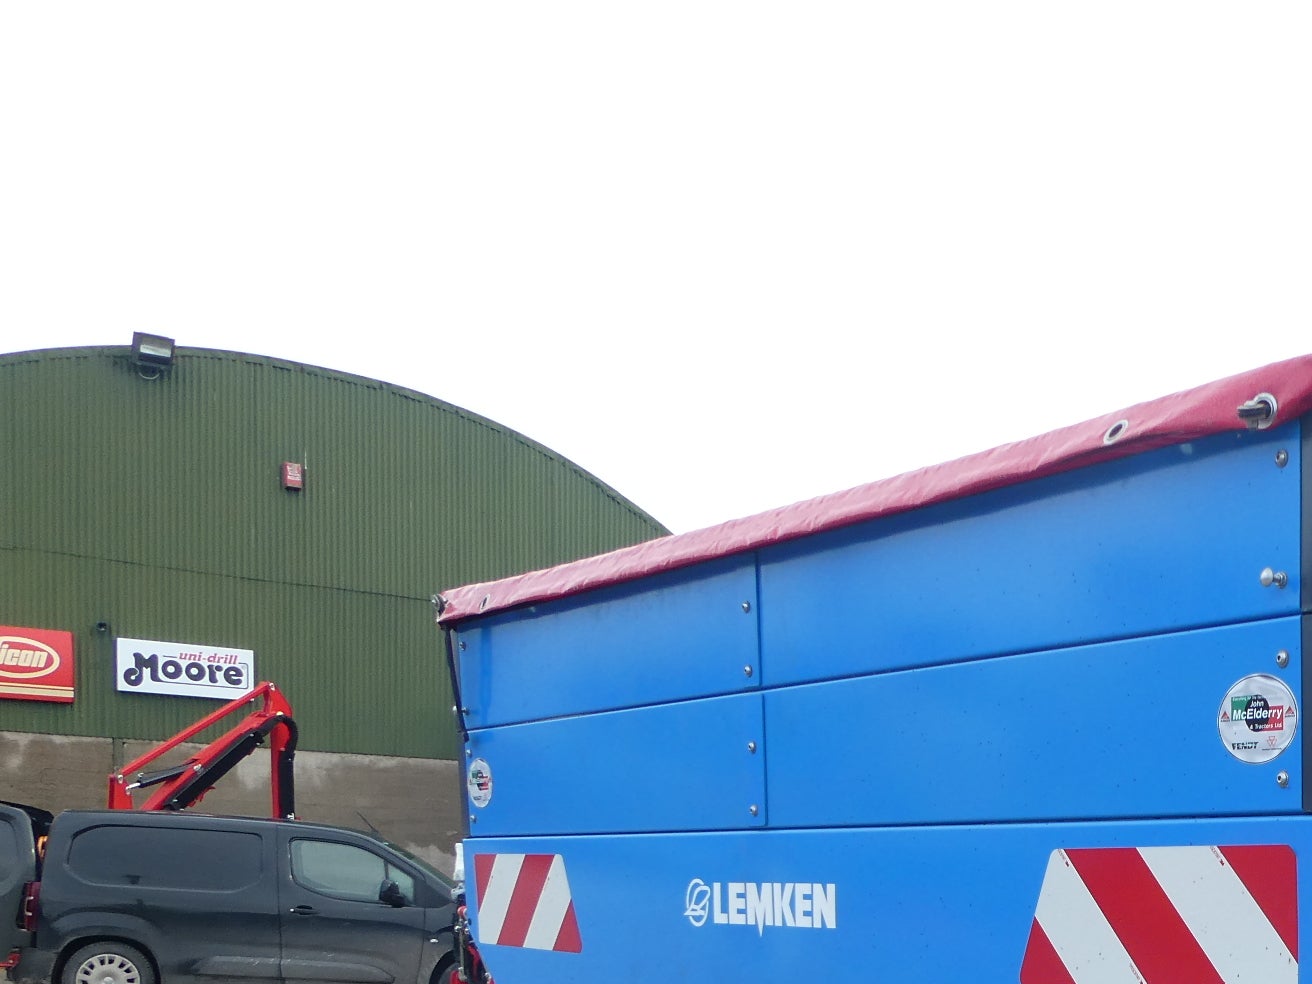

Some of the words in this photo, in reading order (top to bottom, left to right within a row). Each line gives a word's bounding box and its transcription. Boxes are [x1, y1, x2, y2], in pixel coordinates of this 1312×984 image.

[0, 643, 48, 668] icon
[179, 651, 238, 665] uni-drill
[123, 652, 244, 687] Moore
[1250, 700, 1265, 708] John
[1232, 708, 1283, 721] McElderry
[1231, 741, 1259, 750] FENDT
[713, 882, 836, 936] LEMKEN
